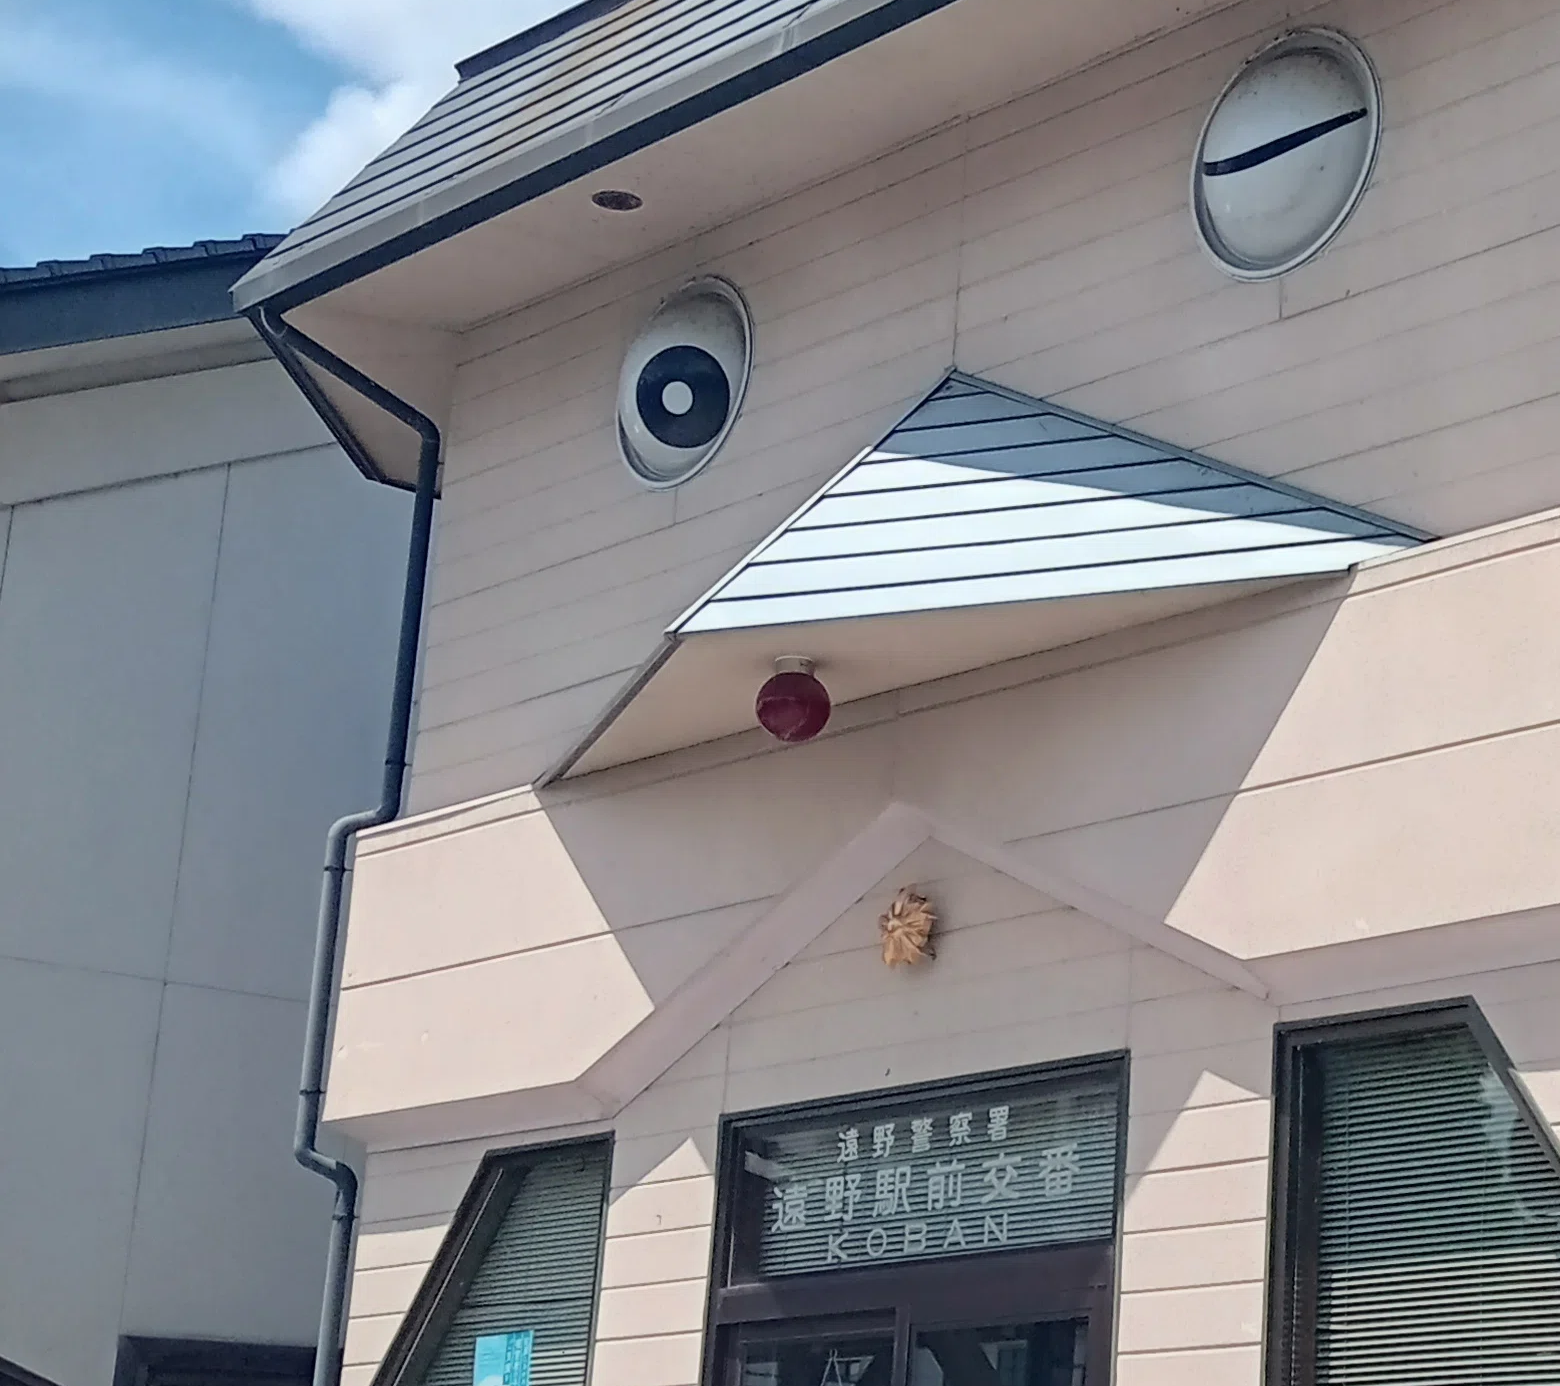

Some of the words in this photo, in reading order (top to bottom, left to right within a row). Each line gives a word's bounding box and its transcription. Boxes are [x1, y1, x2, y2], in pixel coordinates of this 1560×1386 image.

[836, 1106, 1010, 1164] 遠野警察署
[771, 1143, 1080, 1233] 遠野駅前交番
[826, 1212, 1009, 1264] KOBAN
